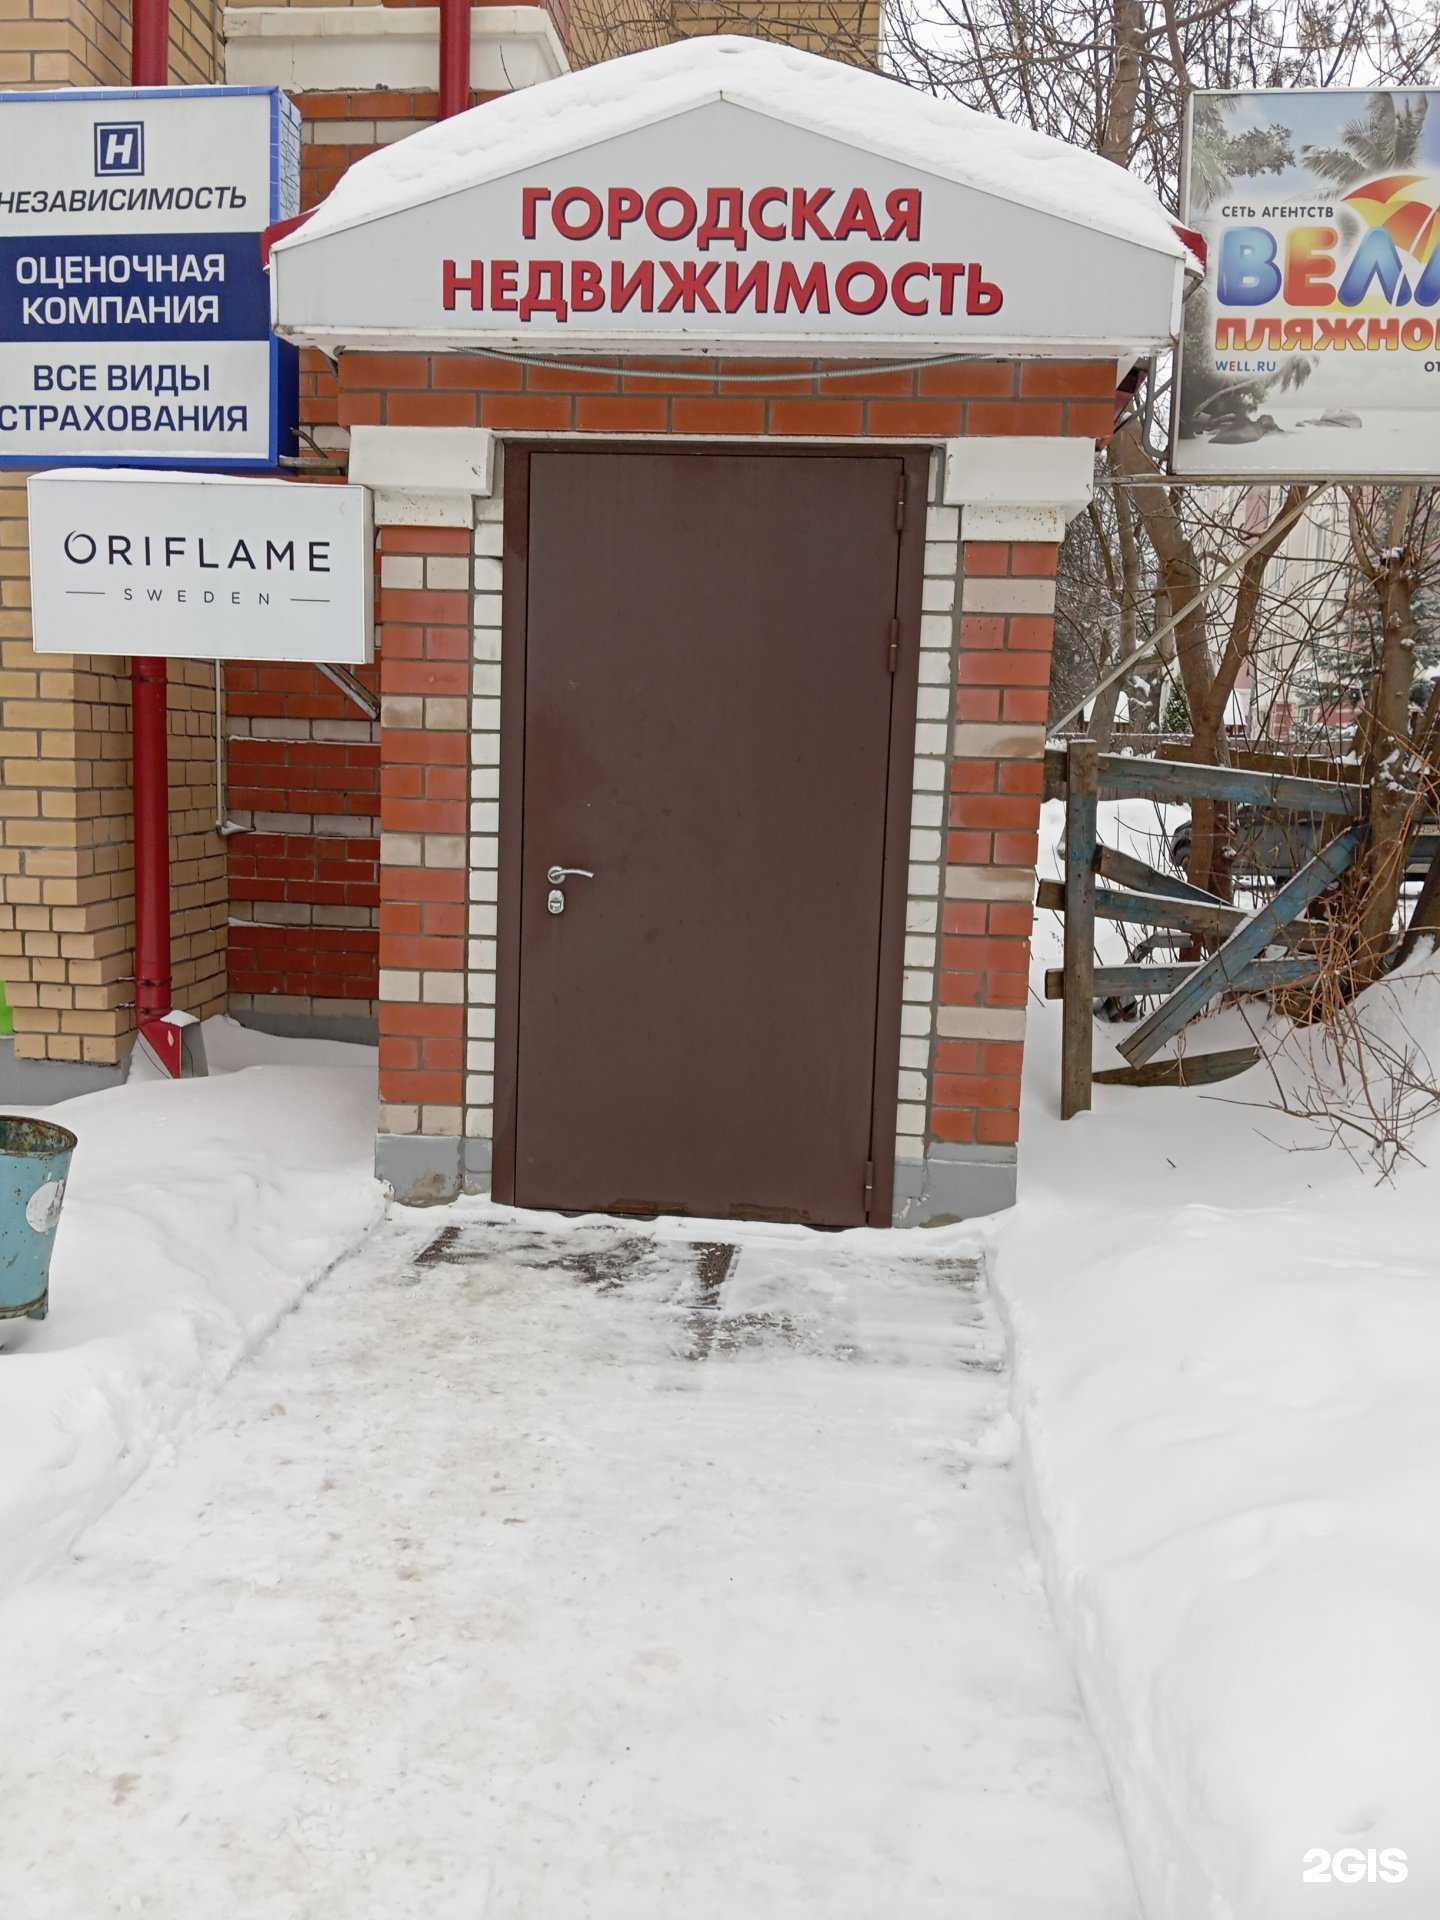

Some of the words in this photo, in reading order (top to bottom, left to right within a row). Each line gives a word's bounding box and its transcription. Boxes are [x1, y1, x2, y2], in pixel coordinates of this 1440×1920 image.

[0, 186, 247, 213] НЕЗАВИСИМОСТЬ
[1222, 204, 1256, 218] СЕТЬ
[1262, 204, 1334, 218] АГЕНТСТВ
[522, 186, 922, 251] ГОРОДСКАЯ
[16, 254, 225, 289] ОЦЕНОЧНАЯ
[442, 259, 1004, 323] НЕДВИЖИМОСТЬ
[22, 295, 220, 325] КОМПАНИЯ
[1215, 317, 1440, 351] ПЛЯЖНО
[33, 365, 97, 391] ВСЕ
[107, 364, 210, 397] ВИДЫ
[1215, 360, 1277, 373] WELL.RU
[0, 404, 247, 432] СТРАХОВАНИЯ
[63, 530, 331, 573] ORIFLAME
[123, 587, 270, 606] SWEDEN
